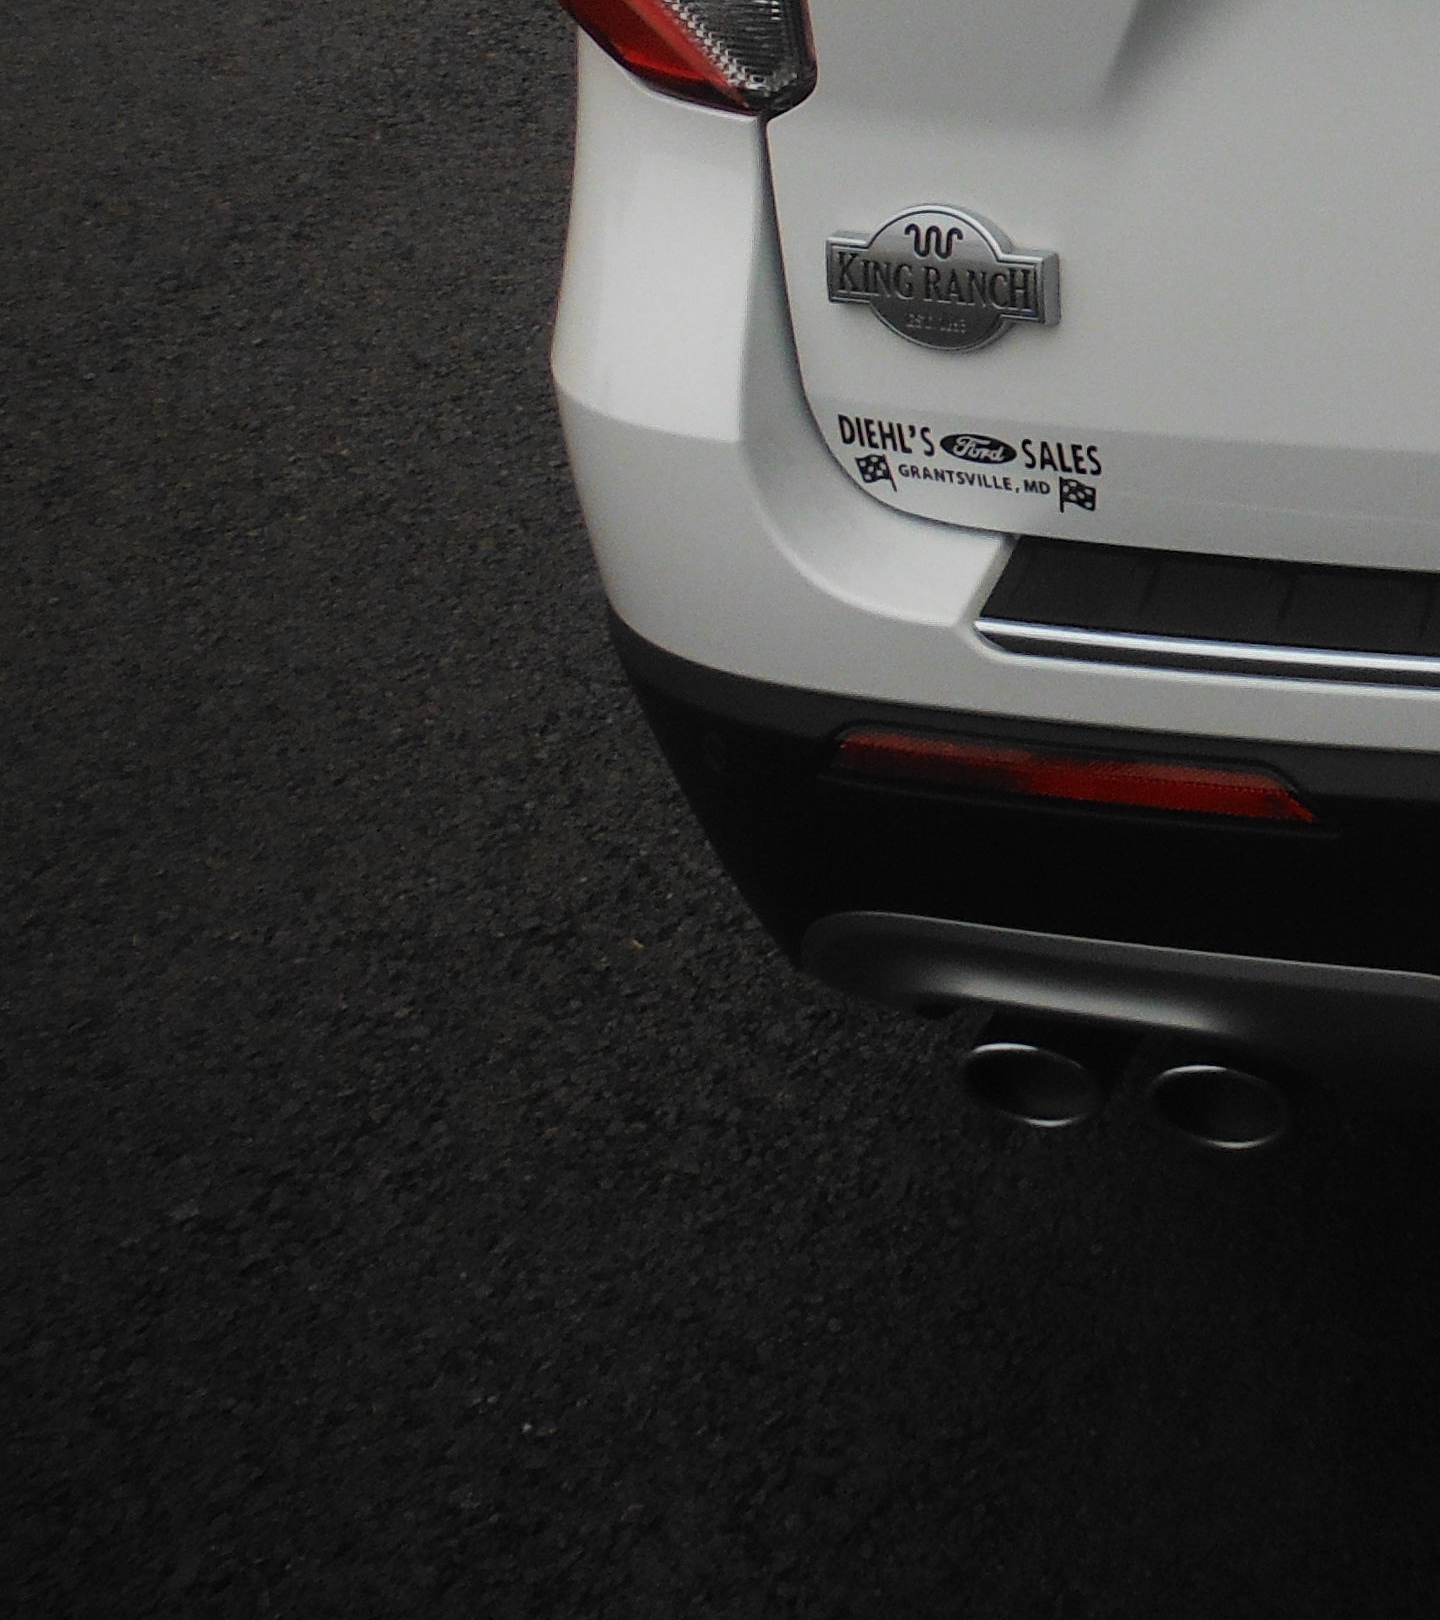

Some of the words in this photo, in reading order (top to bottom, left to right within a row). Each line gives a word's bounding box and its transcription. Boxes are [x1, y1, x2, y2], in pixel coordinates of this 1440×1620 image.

[836, 250, 915, 301] KING
[922, 264, 1034, 311] RANCH
[836, 413, 937, 457] DIEHL'S
[953, 435, 1008, 462] Ford
[1020, 438, 1103, 476] SALES
[897, 463, 1021, 494] GRANTSVILLE,
[1023, 479, 1052, 495] MD
